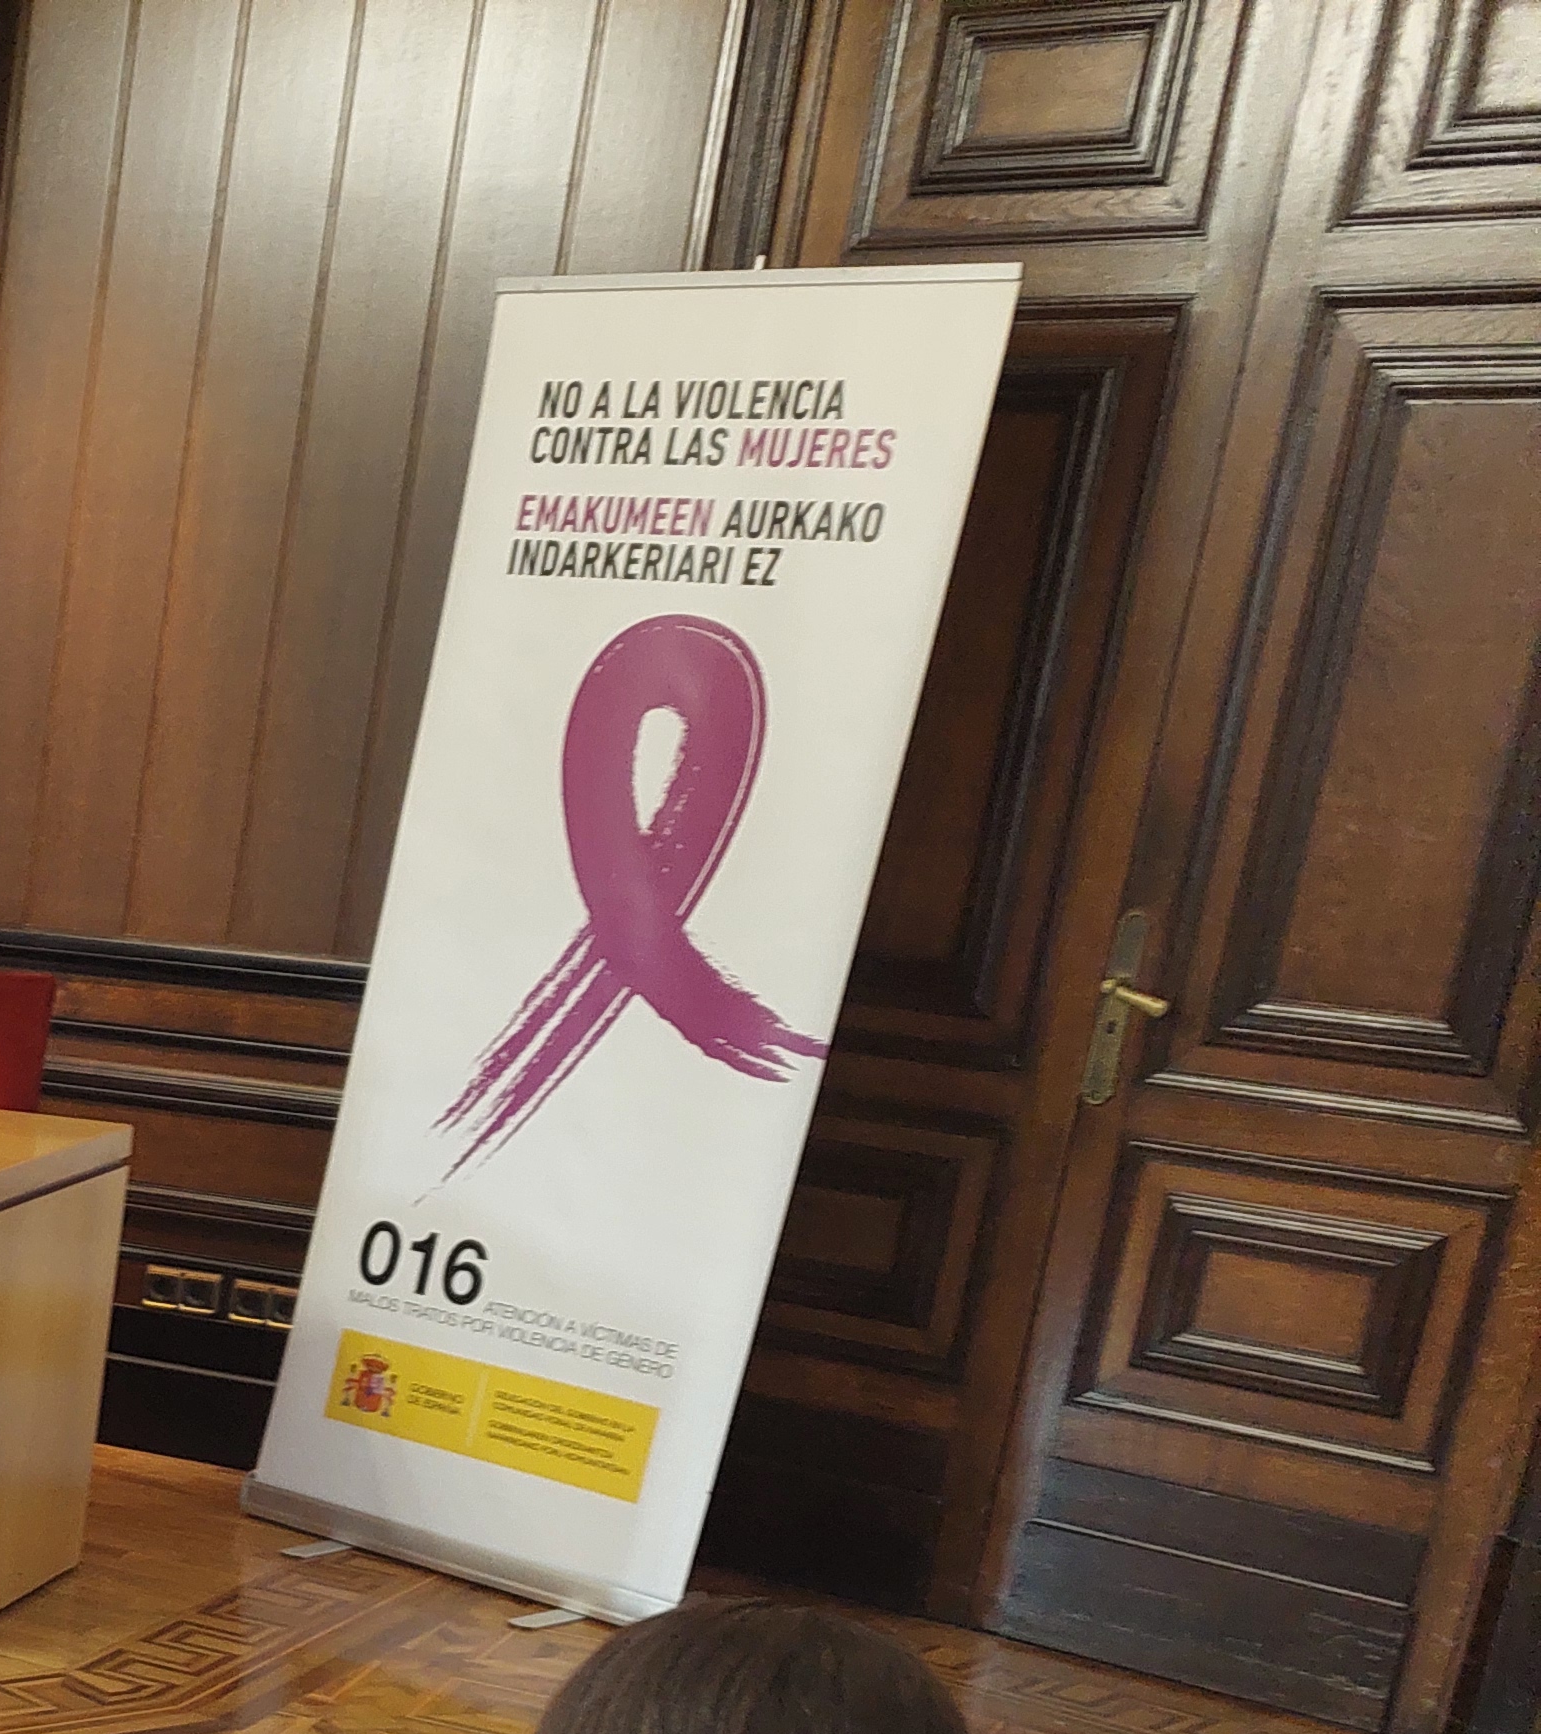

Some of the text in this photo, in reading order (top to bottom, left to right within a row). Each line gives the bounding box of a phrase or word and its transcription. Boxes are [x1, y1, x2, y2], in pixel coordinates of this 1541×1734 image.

[537, 379, 846, 420] NO A LA VIOLENCIA
[530, 426, 898, 469] CONTRA LAS MUJERES
[515, 493, 887, 543] EMAKUMEEN AURKAKO
[505, 539, 784, 587] INDARKERIARI EZ
[359, 1220, 489, 1306] 016
[347, 1288, 400, 1312] MALOS
[462, 1314, 494, 1335] POR
[497, 1322, 578, 1357] VIOLENCIA
[579, 1342, 604, 1362] DE
[655, 1339, 680, 1361] DE
